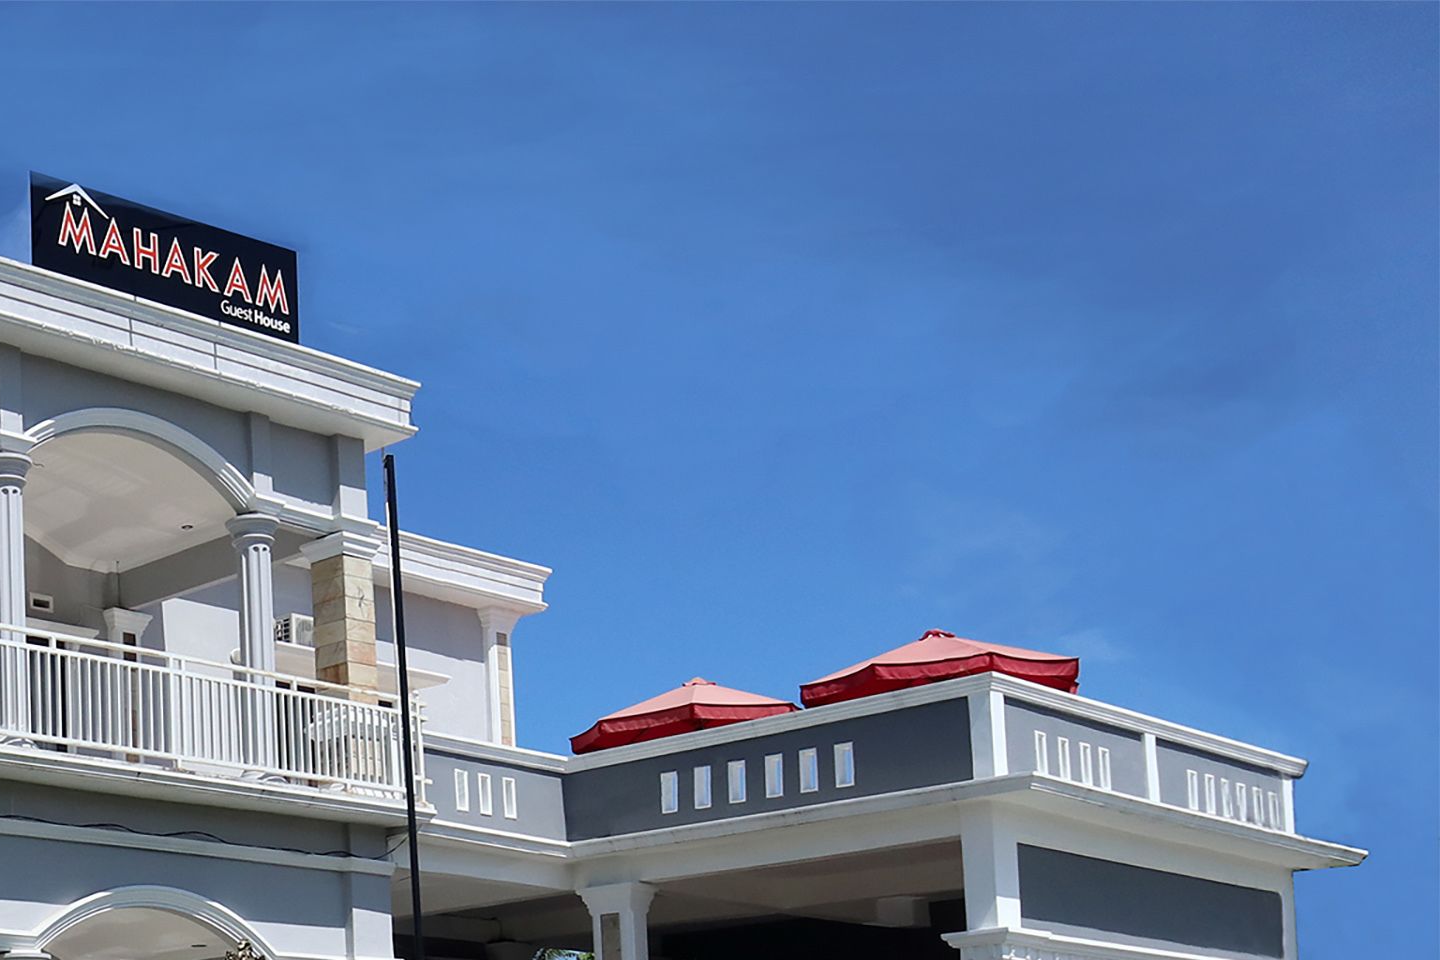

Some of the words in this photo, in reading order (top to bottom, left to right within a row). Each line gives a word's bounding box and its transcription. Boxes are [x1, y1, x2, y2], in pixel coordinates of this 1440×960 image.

[58, 201, 290, 315] MAHAKAM
[220, 299, 253, 322] Guest
[254, 309, 291, 334] House
